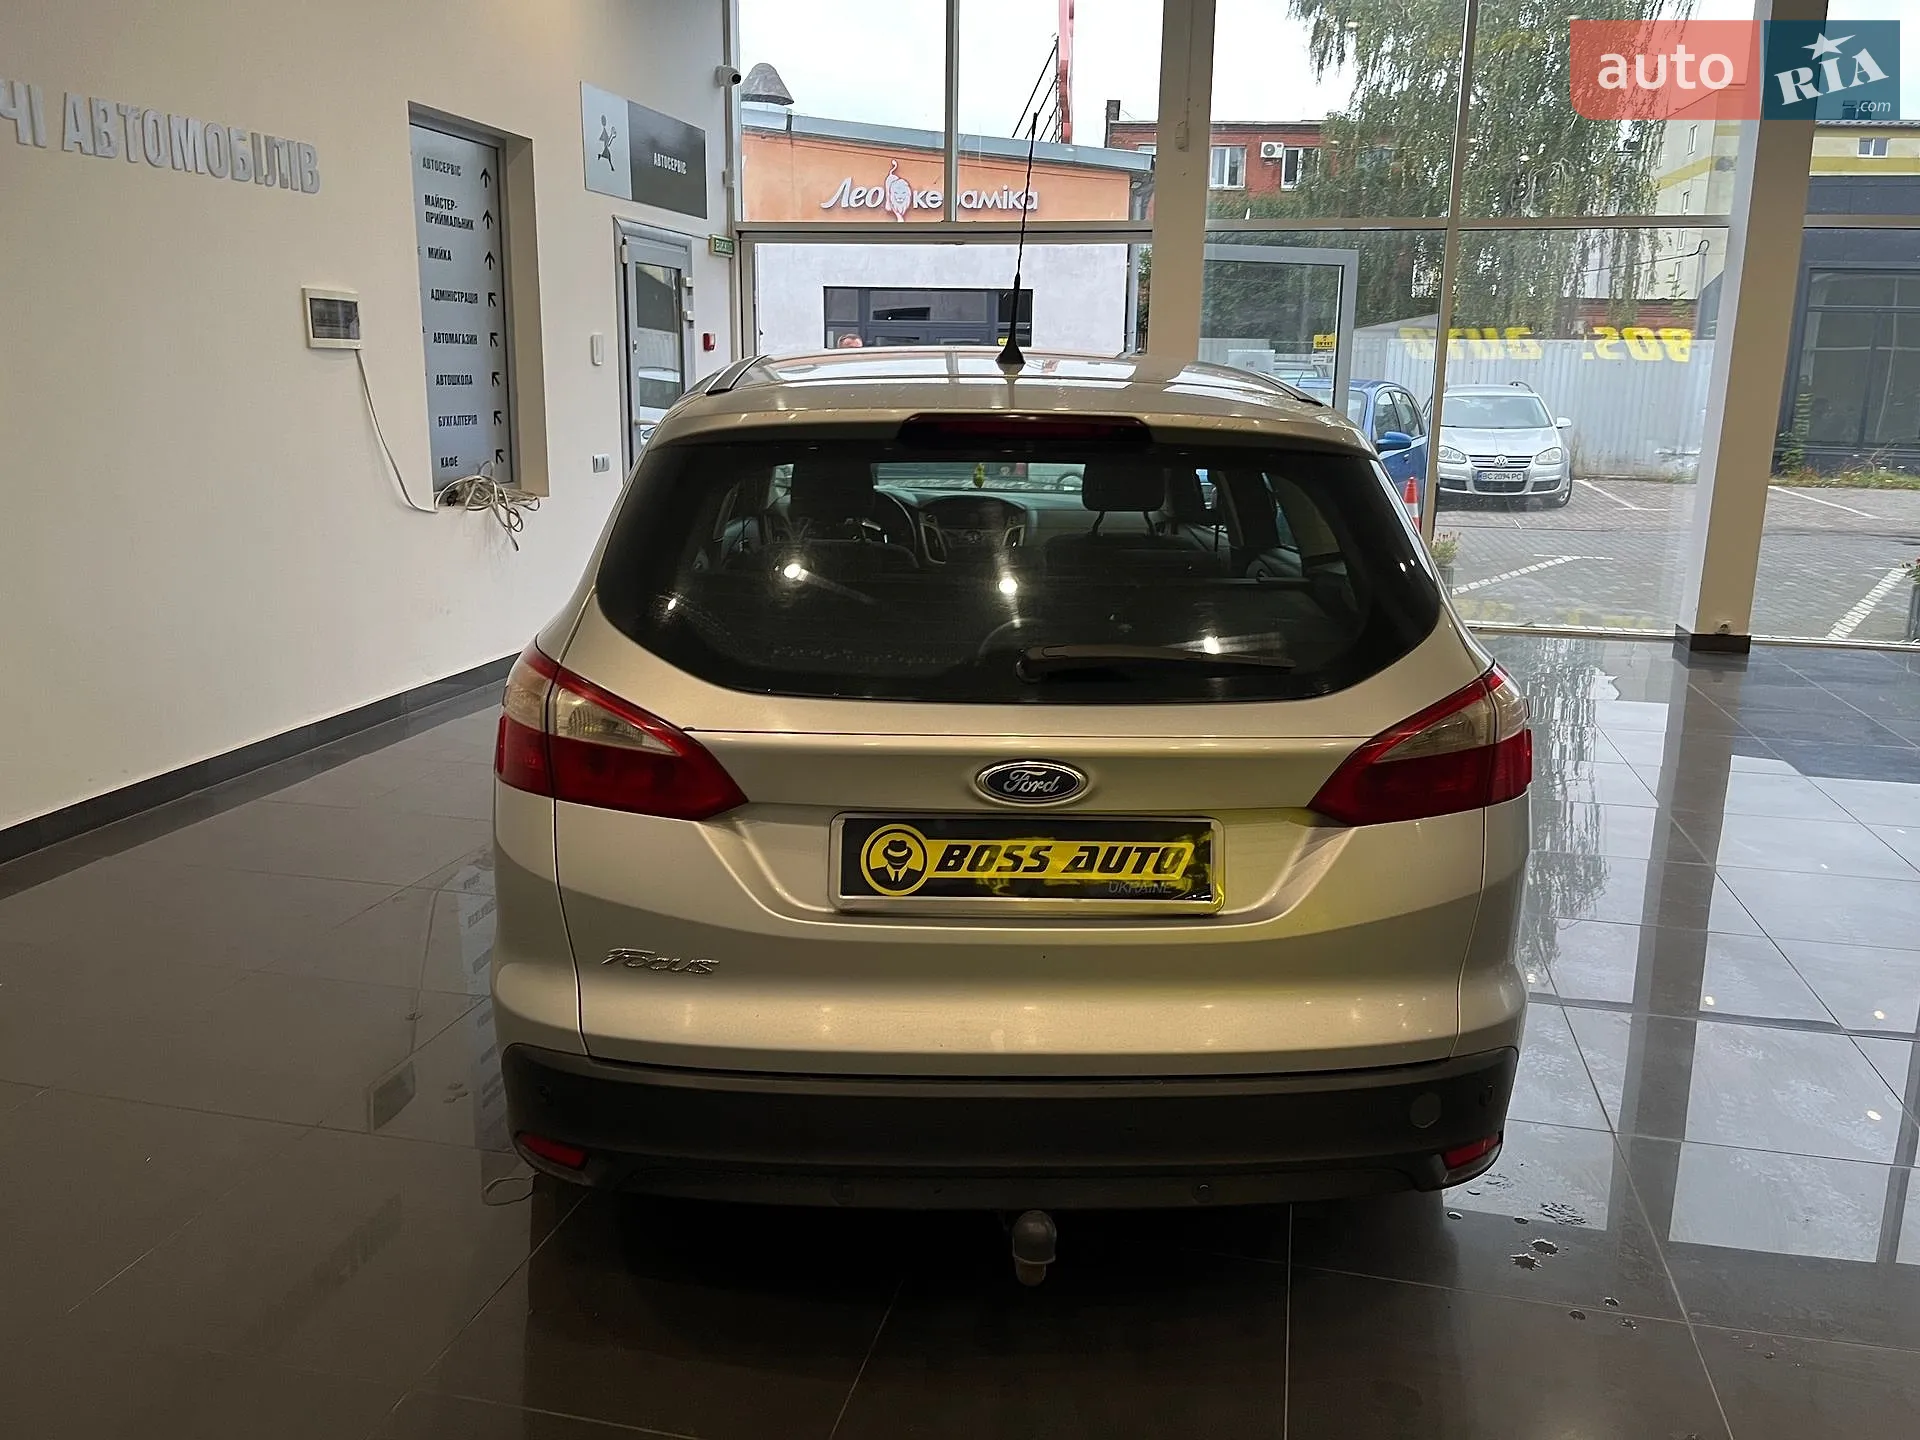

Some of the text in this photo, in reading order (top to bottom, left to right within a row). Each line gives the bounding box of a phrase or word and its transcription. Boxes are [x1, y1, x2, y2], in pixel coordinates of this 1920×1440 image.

[62, 92, 320, 194] АВТОМОБІЛІВ
[422, 157, 462, 176] АВТОСЕРВІС
[653, 152, 687, 175] АВТОСЕРВІС
[820, 177, 1039, 210] Лео кеаміка
[424, 194, 458, 210] МАЙСТЕР-
[425, 211, 474, 230] ПРИЙМАЛЬНИК
[428, 246, 452, 261] МИЙКА
[430, 288, 479, 304] АДМІНІСТРАЦІЯ
[433, 332, 478, 345] АВТОМАГАЗИН
[435, 374, 473, 386] АВТОШКОЛА
[438, 414, 478, 427] БУХГАЛТЕРІЯ
[440, 456, 458, 468] КАФЕ
[1003, 769, 1061, 793] Ford
[934, 843, 1188, 876] BOSS AUTO
[1107, 880, 1173, 895] UKRAINE
